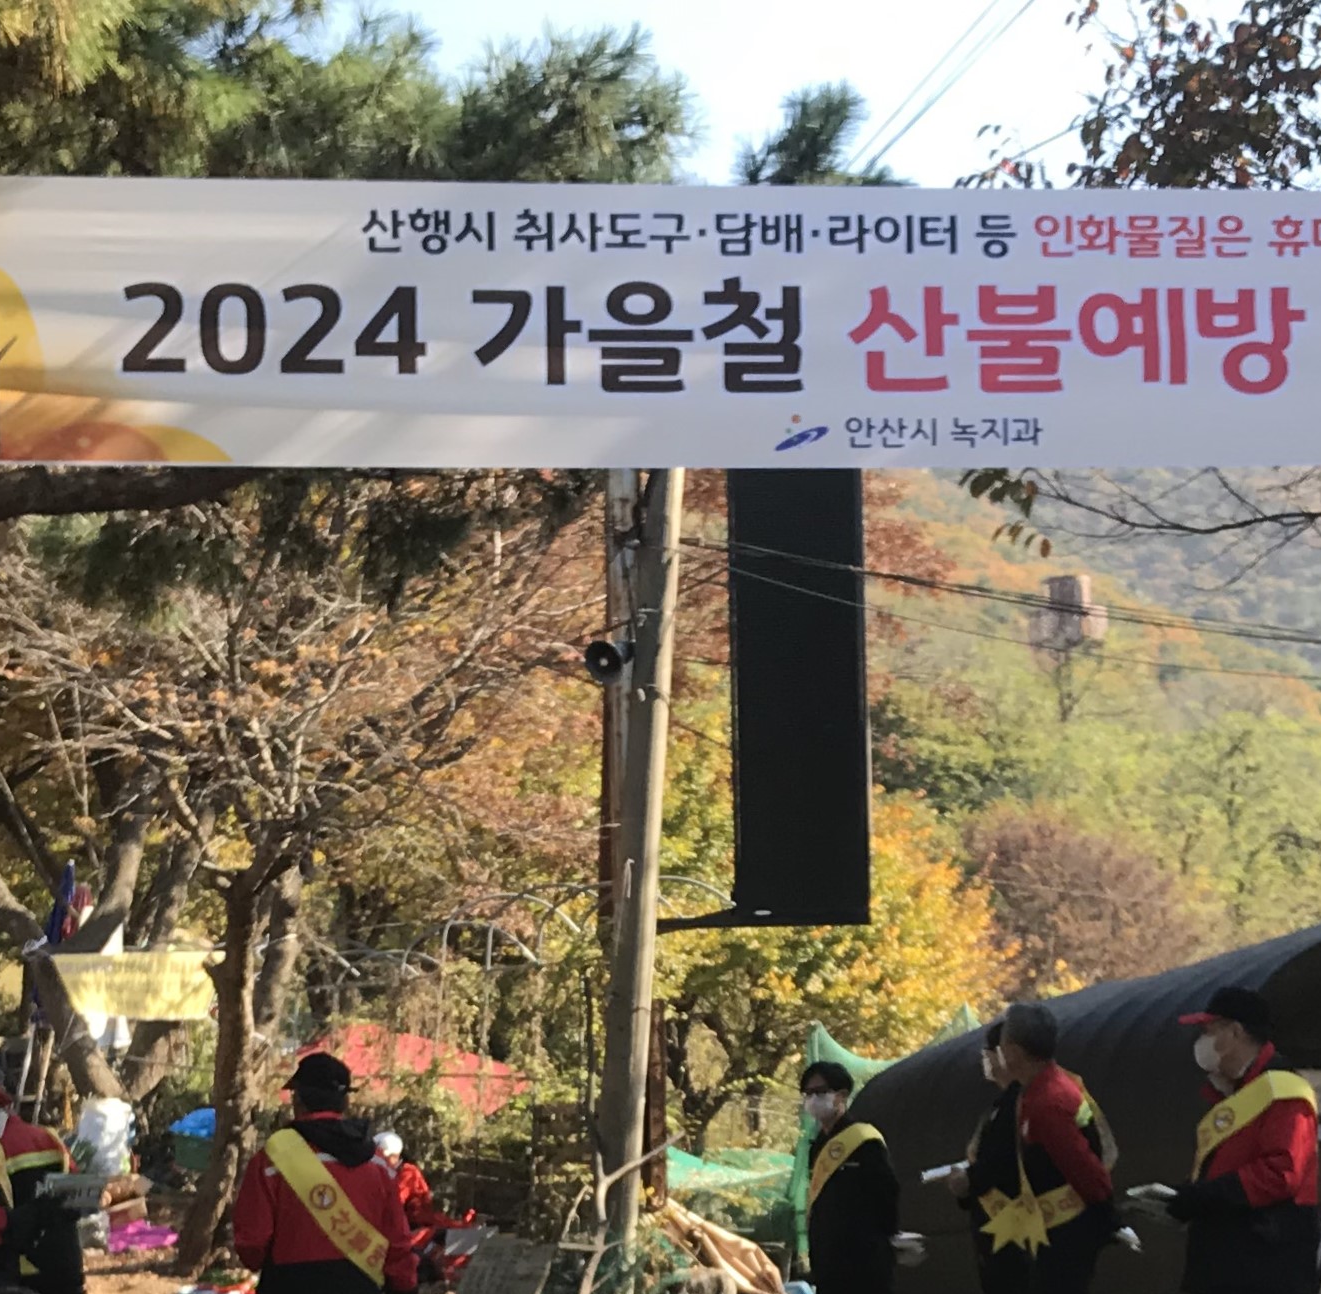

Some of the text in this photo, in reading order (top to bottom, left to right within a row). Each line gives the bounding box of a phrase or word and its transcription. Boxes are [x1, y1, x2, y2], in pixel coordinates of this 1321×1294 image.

[362, 208, 495, 255] 산행시
[975, 215, 1017, 258] 등
[1034, 213, 1251, 259] 인화물질은
[122, 282, 427, 376] 2024
[472, 276, 804, 393] 가을철
[848, 284, 1306, 395] 산불예방
[844, 416, 1043, 449] 안산시 녹지과
